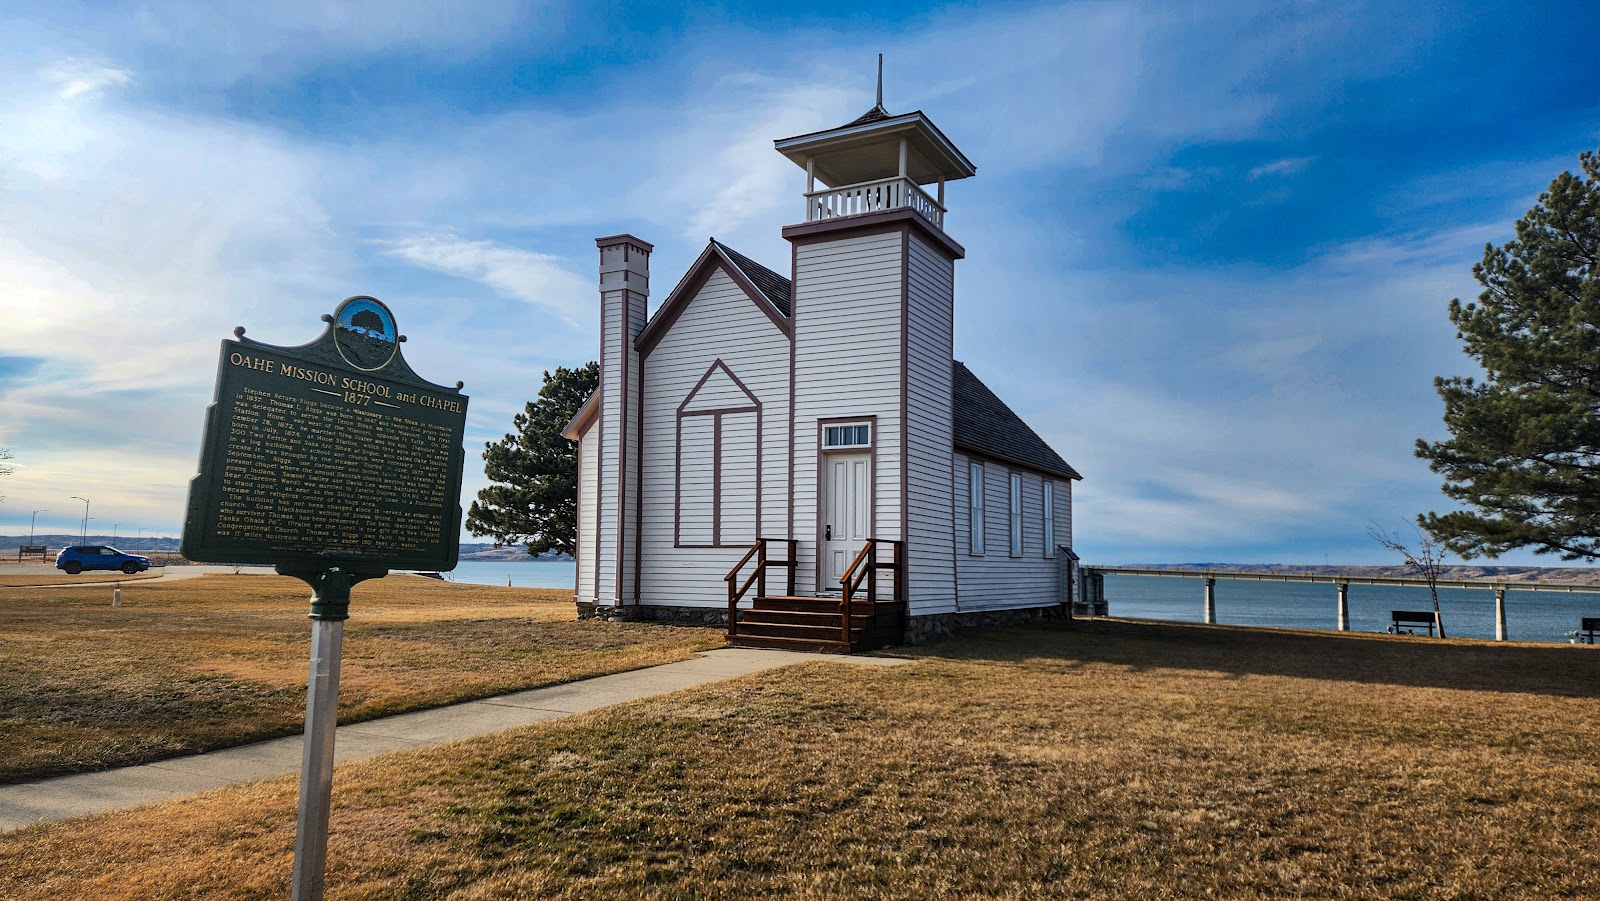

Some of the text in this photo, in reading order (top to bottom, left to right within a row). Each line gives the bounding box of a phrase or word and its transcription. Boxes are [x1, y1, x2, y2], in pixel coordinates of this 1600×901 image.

[230, 352, 462, 414] OAHE MISSION SCHOOL and CHAPEL
[344, 391, 371, 406] 1877
